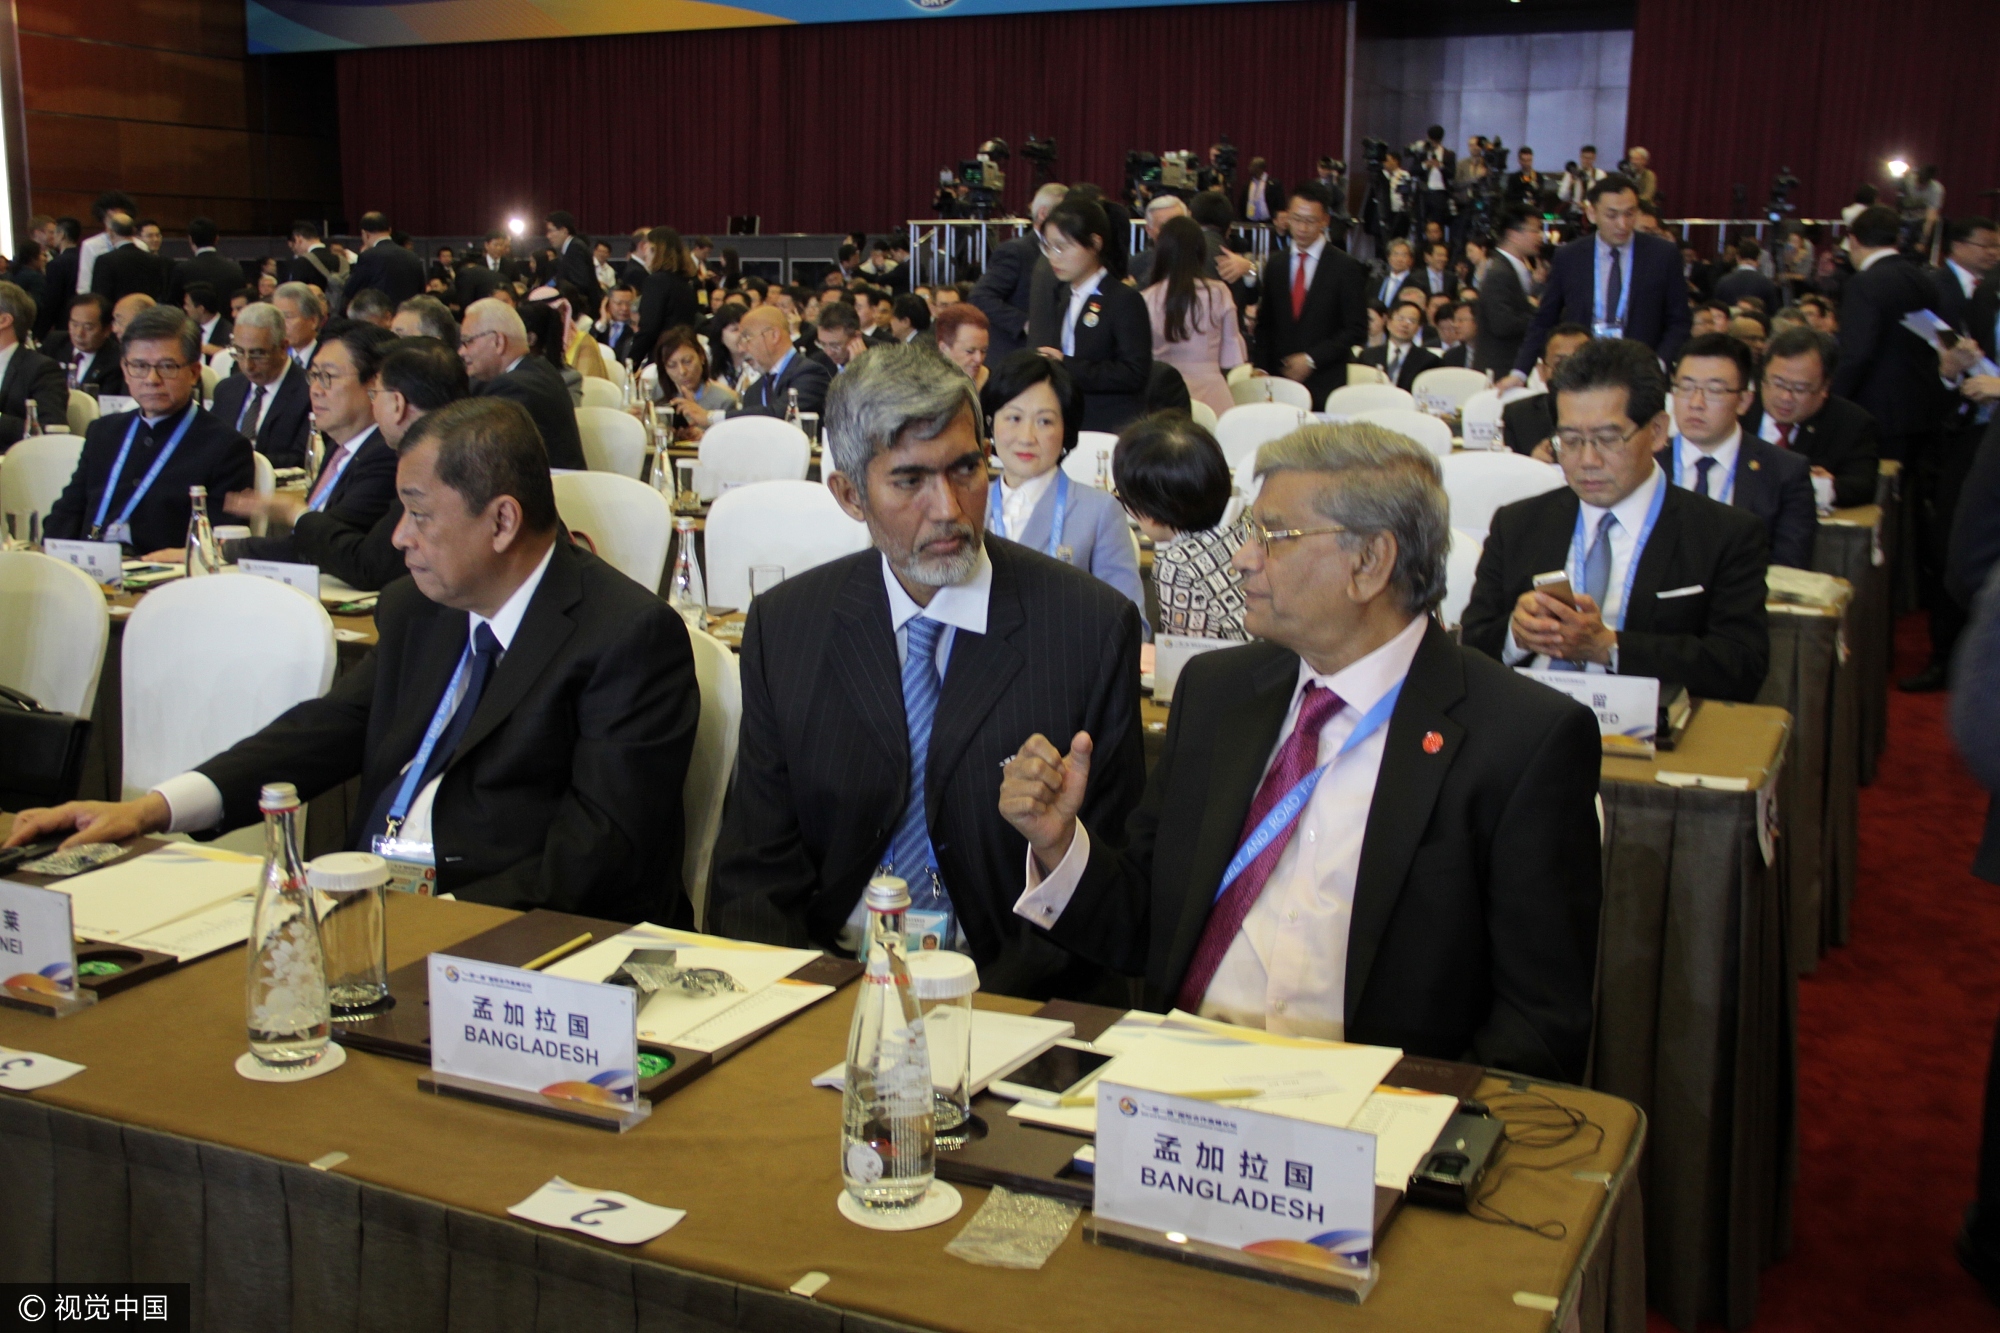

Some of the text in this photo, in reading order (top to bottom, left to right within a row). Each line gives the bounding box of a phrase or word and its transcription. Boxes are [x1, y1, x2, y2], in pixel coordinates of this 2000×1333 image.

[1222, 857, 1244, 886] BELT
[1246, 828, 1269, 858] AND
[1268, 794, 1300, 831] ROAD
[464, 1024, 599, 1067] BANGLADESH
[472, 994, 589, 1040] 孟加拉国
[1153, 1132, 1314, 1192] 孟加拉国
[1140, 1165, 1325, 1225] BANGLADESH
